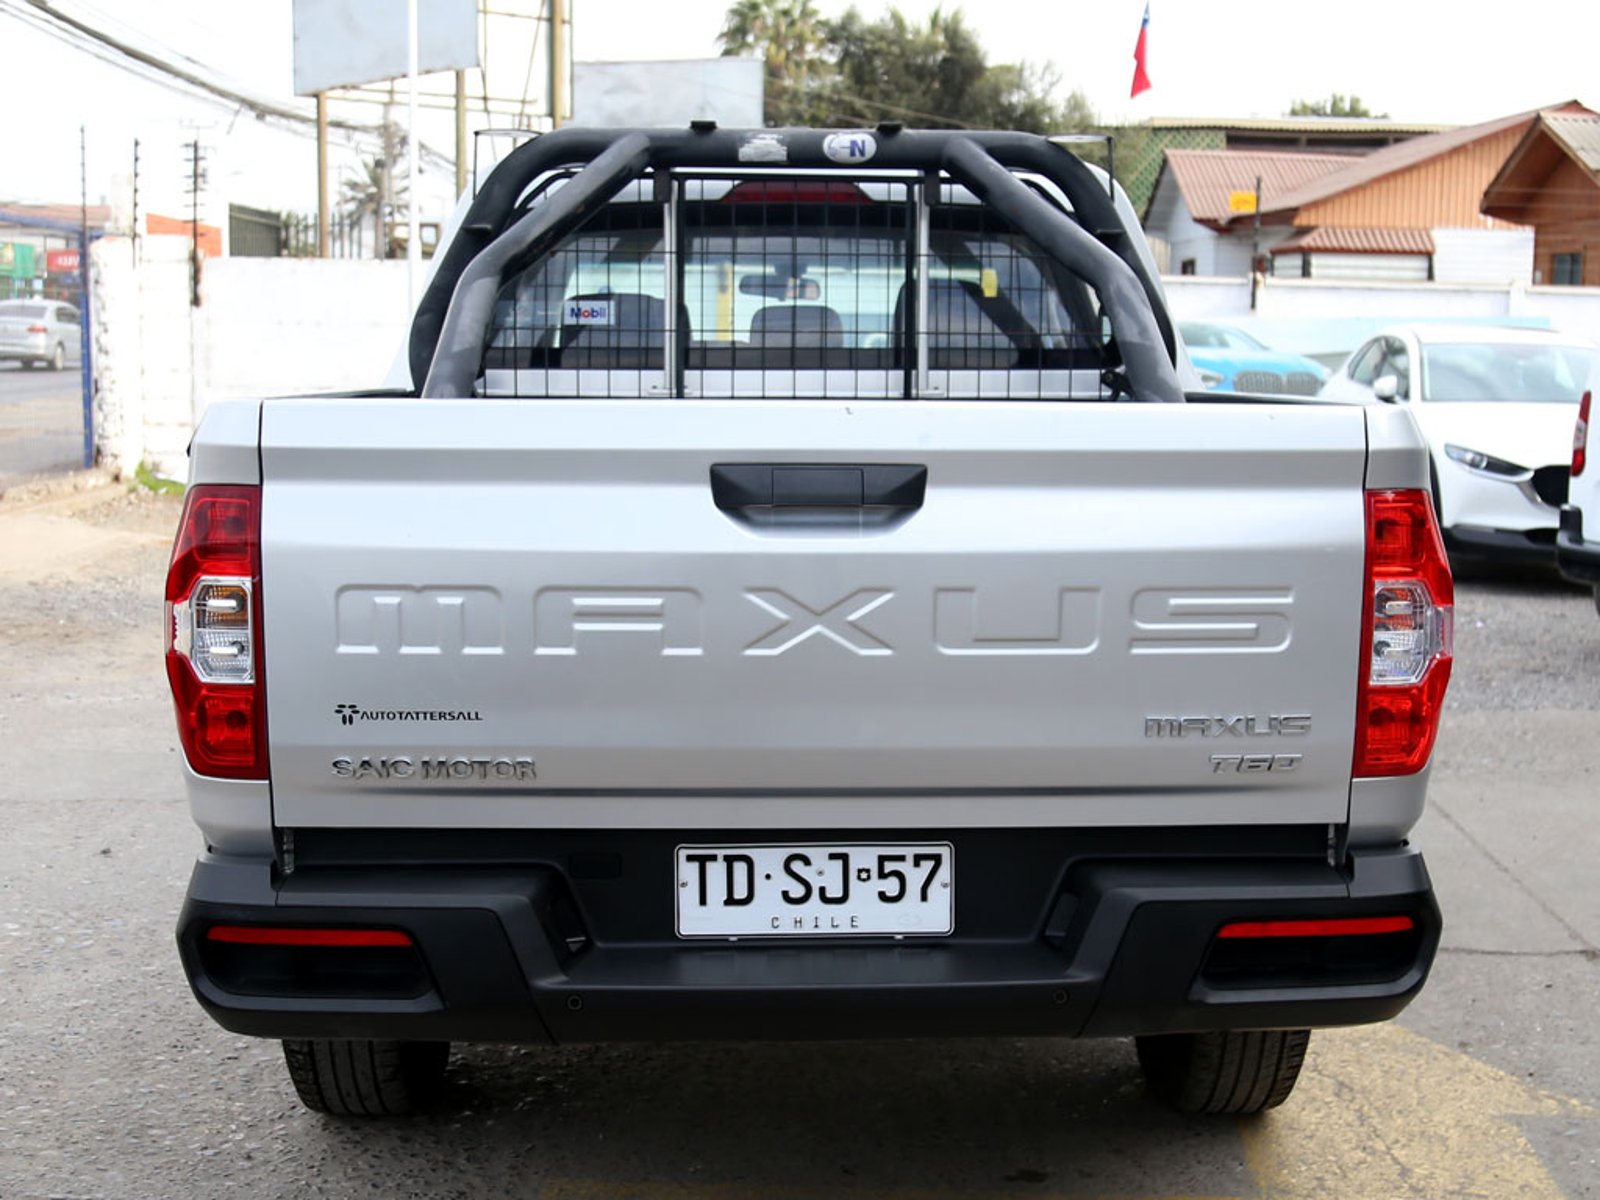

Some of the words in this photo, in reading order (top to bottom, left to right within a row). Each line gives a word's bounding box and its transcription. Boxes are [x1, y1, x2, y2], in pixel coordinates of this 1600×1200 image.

[569, 307, 606, 318] Mobil
[335, 583, 1295, 656] MAXUS
[1145, 714, 1312, 738] MAXUS
[331, 756, 415, 778] SAIC
[420, 757, 536, 779] MOTOR
[1208, 754, 1303, 773] T60
[771, 916, 859, 929] CHILE
